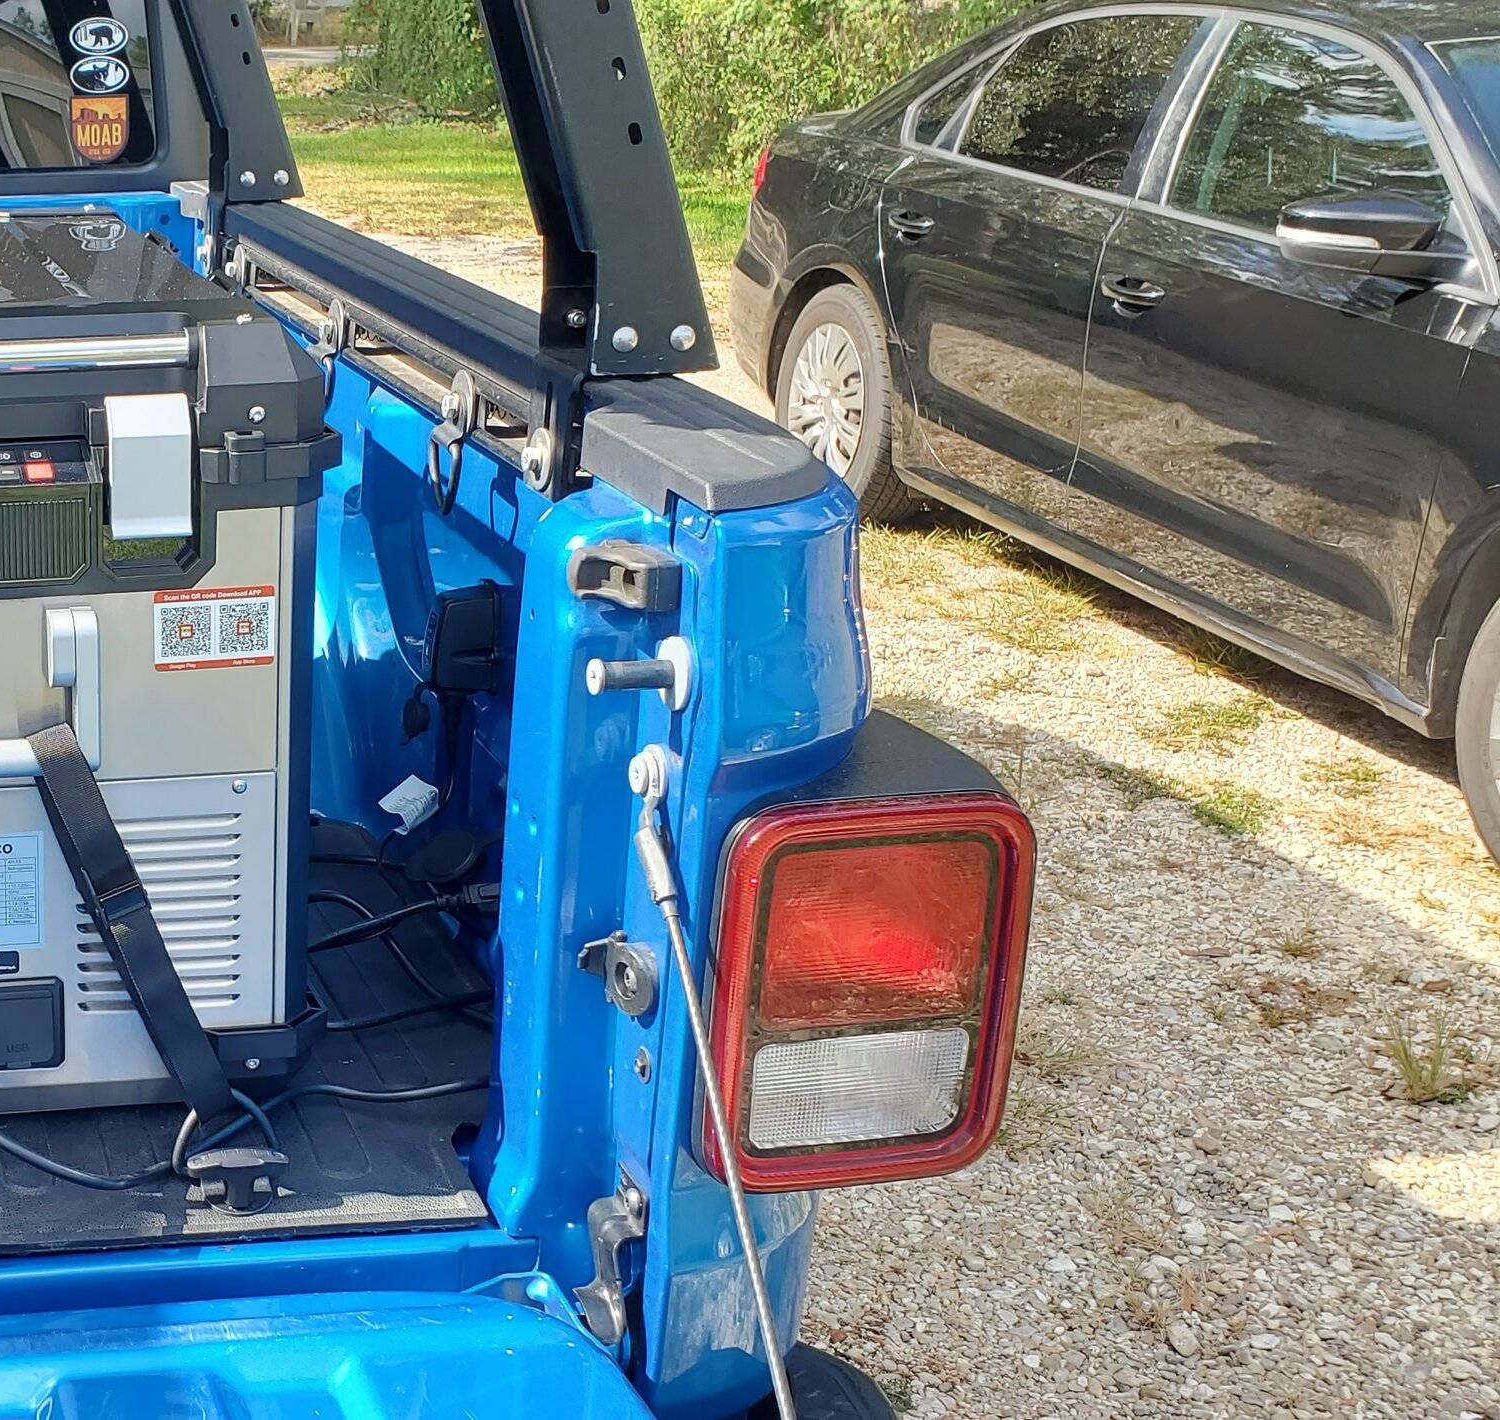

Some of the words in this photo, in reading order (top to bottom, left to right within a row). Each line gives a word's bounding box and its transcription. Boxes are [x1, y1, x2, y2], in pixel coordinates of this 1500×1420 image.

[77, 123, 122, 147] MOAB
[218, 590, 248, 598] Download
[7, 1043, 29, 1054] USB
